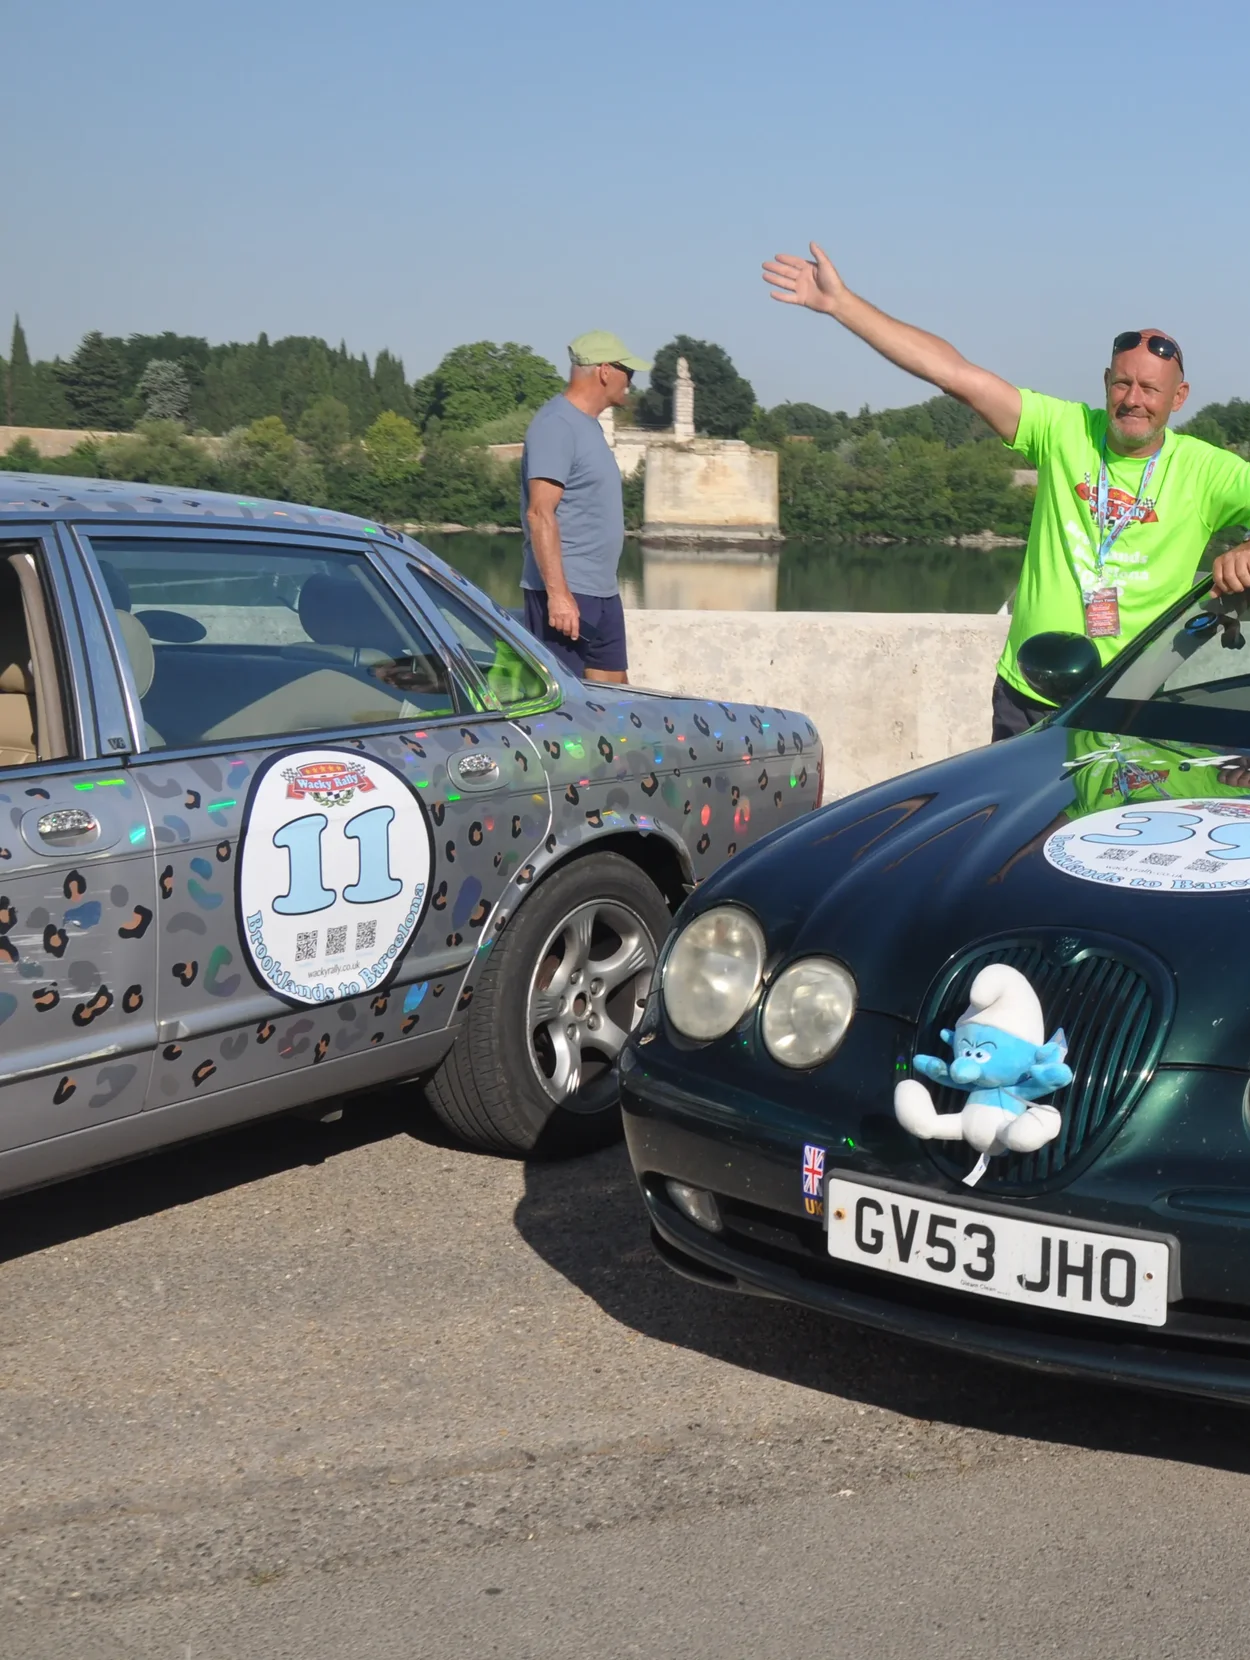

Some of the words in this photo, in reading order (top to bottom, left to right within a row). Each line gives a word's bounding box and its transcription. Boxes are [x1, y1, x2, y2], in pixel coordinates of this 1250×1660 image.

[298, 777, 332, 791] Wacky
[334, 773, 359, 787] Rally
[272, 805, 403, 916] 11
[1047, 833, 1125, 884] Brooklands
[1129, 876, 1163, 889] to
[1104, 864, 1185, 880] wackyrally.co.uk
[246, 909, 335, 1002] Brooklands
[339, 981, 360, 997] to
[359, 882, 425, 986] Barcelona
[307, 960, 360, 979] wackyrally.co.uk
[804, 1197, 824, 1216] UK
[855, 1196, 996, 1283] GV53
[1016, 1237, 1137, 1308] JHO
